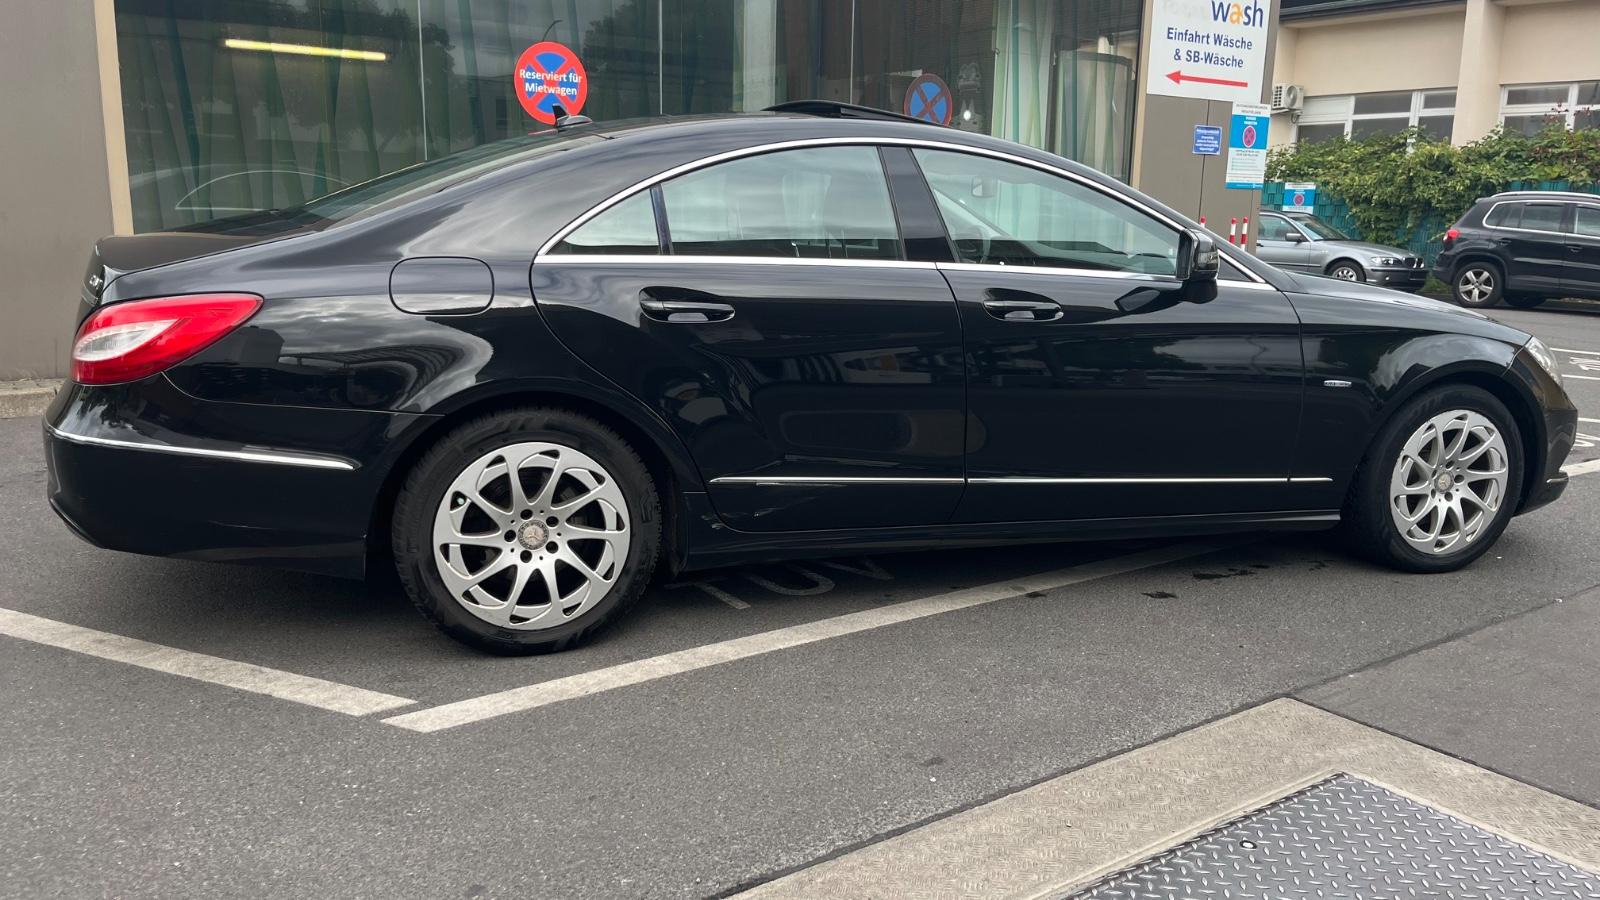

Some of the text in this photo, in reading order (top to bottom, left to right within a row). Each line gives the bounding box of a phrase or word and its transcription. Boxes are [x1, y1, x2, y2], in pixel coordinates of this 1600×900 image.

[1212, 0, 1264, 28] wash
[1167, 27, 1253, 50] Einfahrt Wäsche
[1174, 48, 1244, 68] & SB-Wäsche
[520, 69, 583, 83] Reserviert für
[525, 82, 577, 96] Mietwagen
